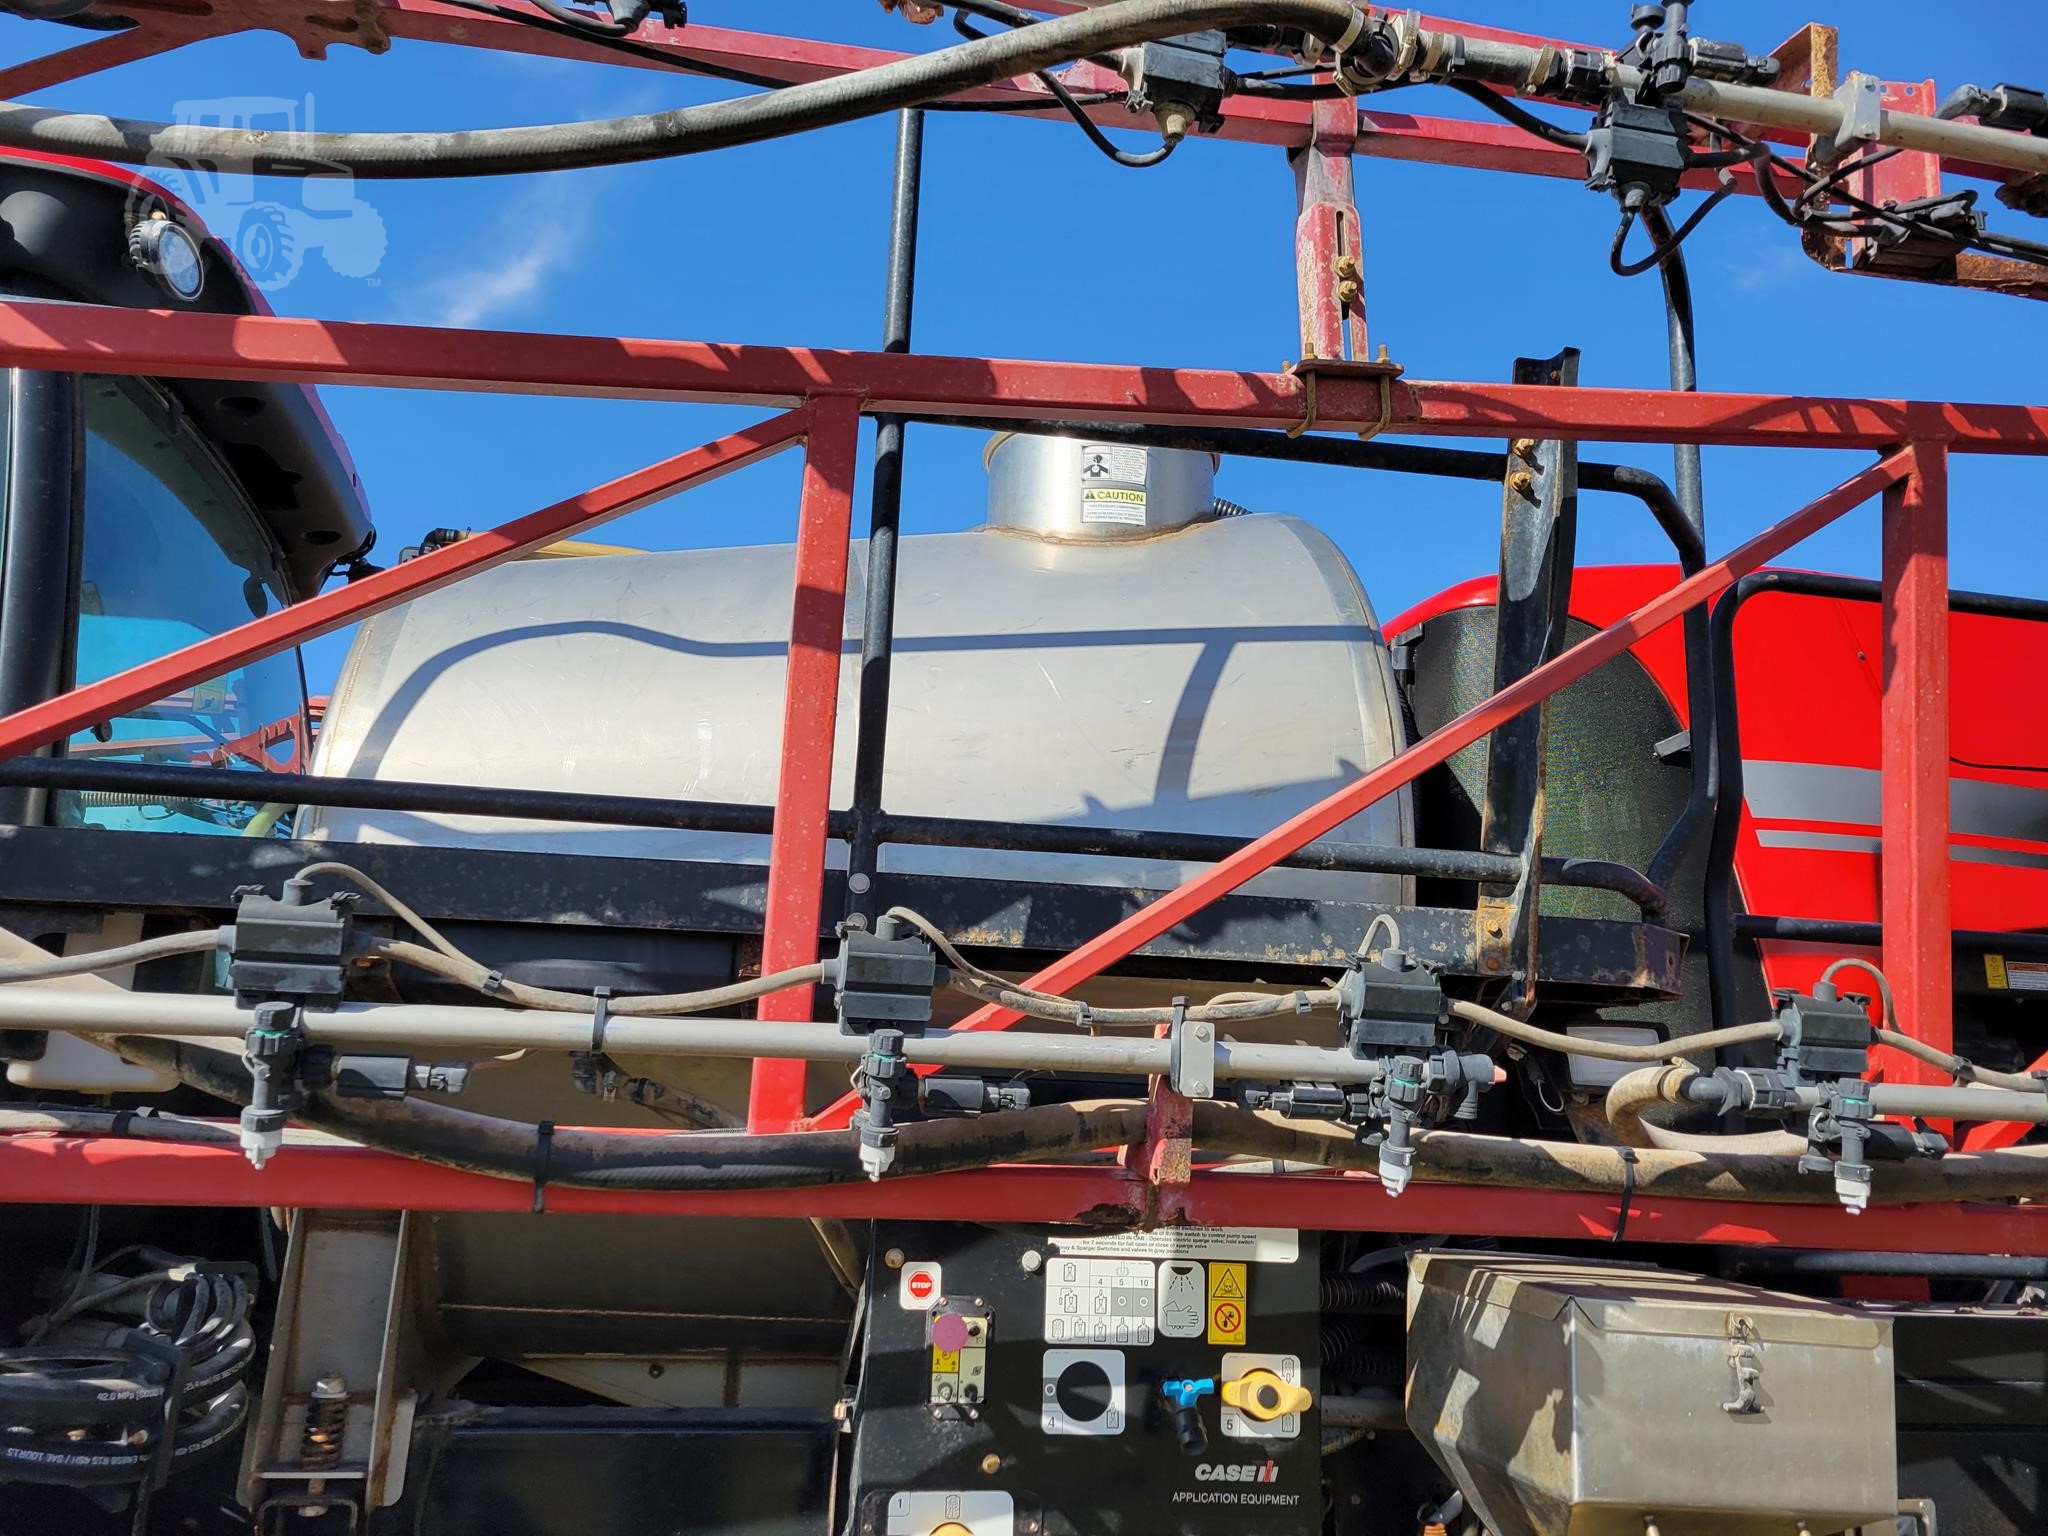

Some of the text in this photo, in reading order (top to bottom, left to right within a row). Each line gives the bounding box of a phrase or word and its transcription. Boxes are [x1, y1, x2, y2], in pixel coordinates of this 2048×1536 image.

[1097, 490, 1144, 502] CAUTION
[911, 1281, 932, 1289] STOP
[1119, 1278, 1124, 1286] 5
[1139, 1279, 1149, 1287] 10
[1047, 1416, 1055, 1428] 4
[1226, 1418, 1234, 1430] 5
[1194, 1463, 1257, 1482] CASE
[897, 1497, 903, 1510] 1
[1171, 1491, 1300, 1506] APPLICATION EQUIPMENT
